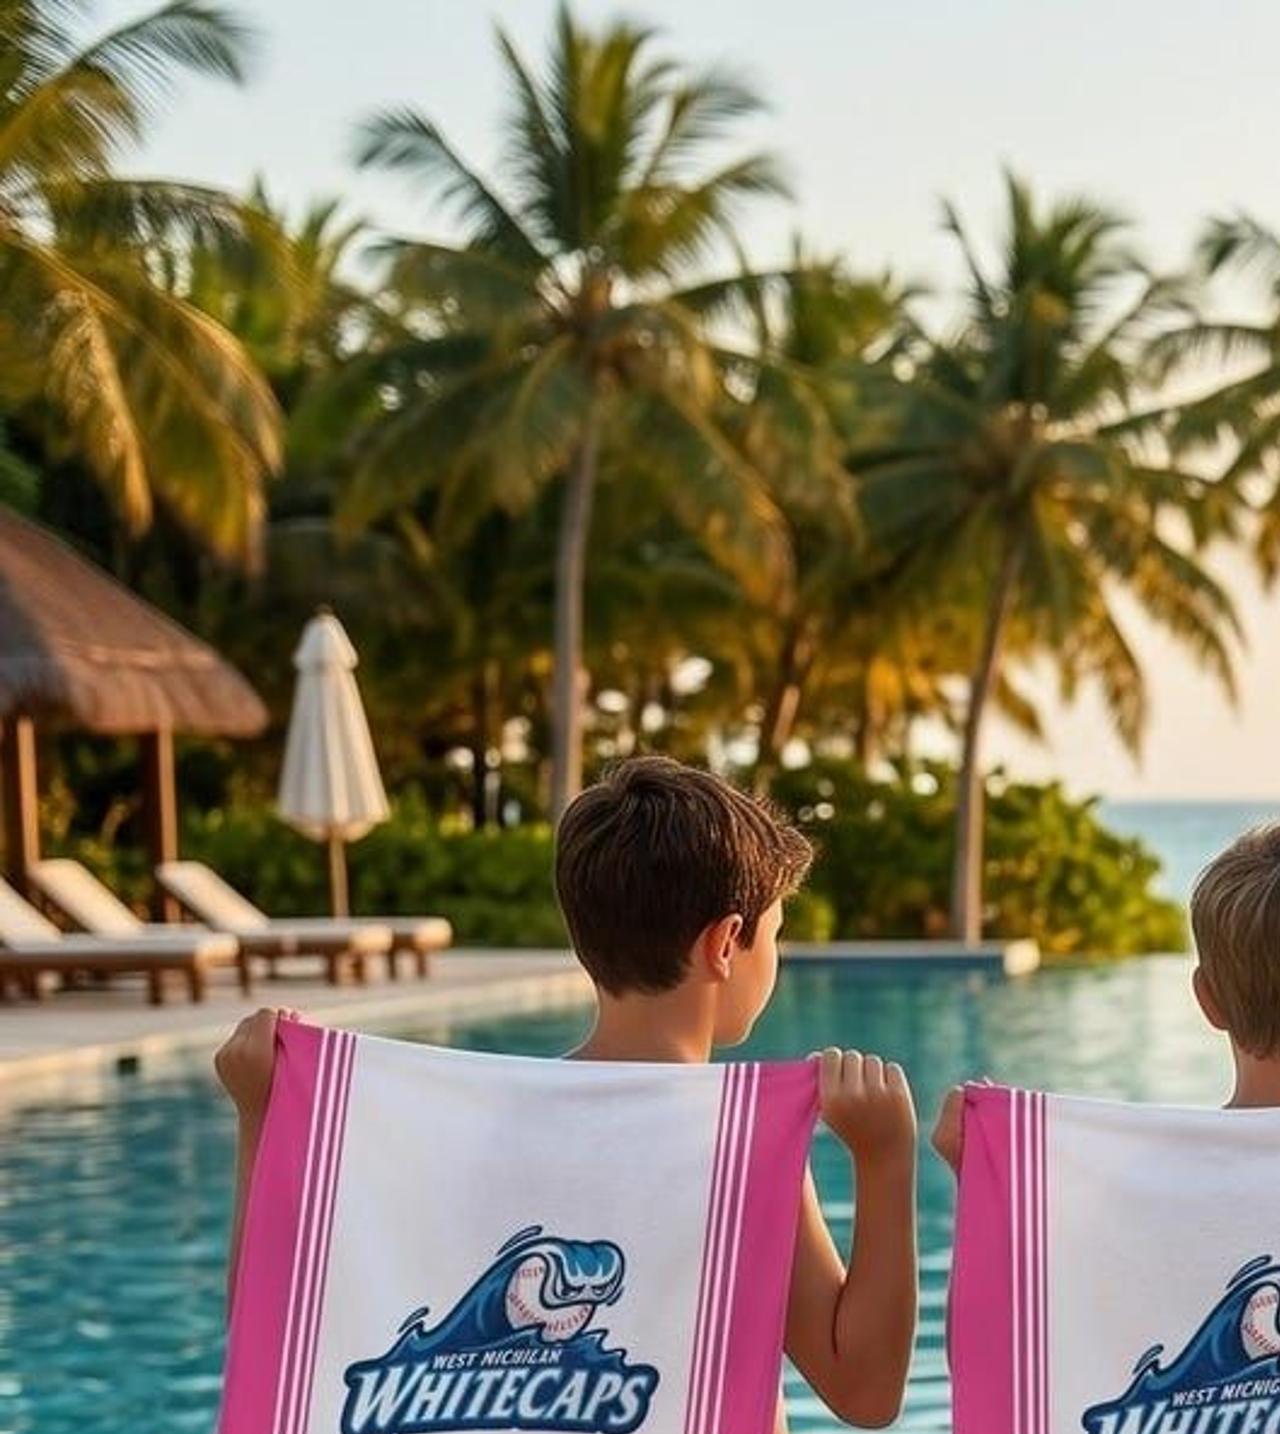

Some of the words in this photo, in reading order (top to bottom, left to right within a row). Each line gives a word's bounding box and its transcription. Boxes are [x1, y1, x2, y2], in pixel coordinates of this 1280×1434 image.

[432, 1352, 476, 1369] WEST
[348, 1362, 650, 1433] WHITECAPS
[1173, 1387, 1217, 1406] WEST
